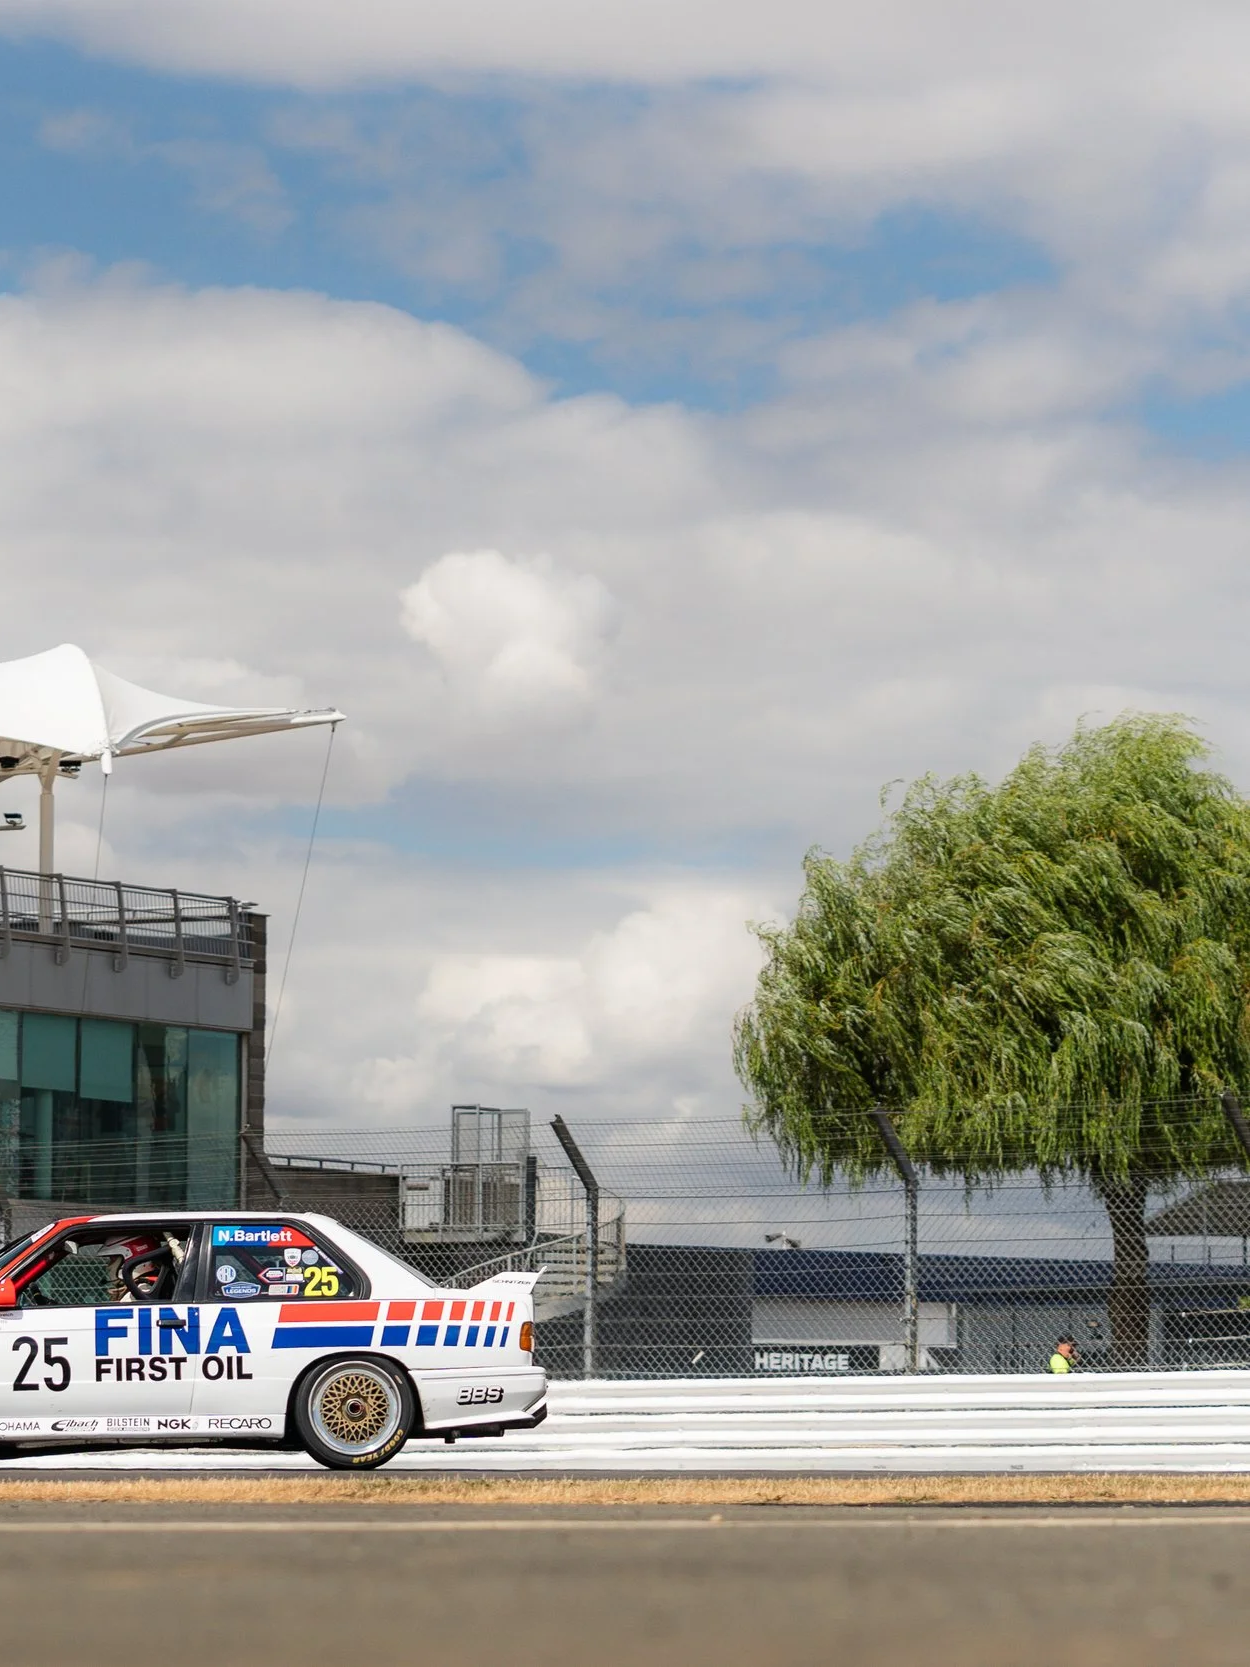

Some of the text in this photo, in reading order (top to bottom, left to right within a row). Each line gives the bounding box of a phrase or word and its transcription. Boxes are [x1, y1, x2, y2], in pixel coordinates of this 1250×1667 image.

[218, 1230, 292, 1242] N.Bartlett
[304, 1267, 339, 1296] 25
[95, 1307, 251, 1356] FINA
[12, 1336, 71, 1392] 25
[95, 1355, 253, 1382] FIRST OIL
[754, 1352, 850, 1370] HERITAGE
[456, 1385, 504, 1405] BBS
[106, 1418, 150, 1427] BILSTEIN
[157, 1418, 191, 1430] NGK
[208, 1418, 272, 1429] RECARO
[352, 1429, 404, 1464] GOODYEAR
